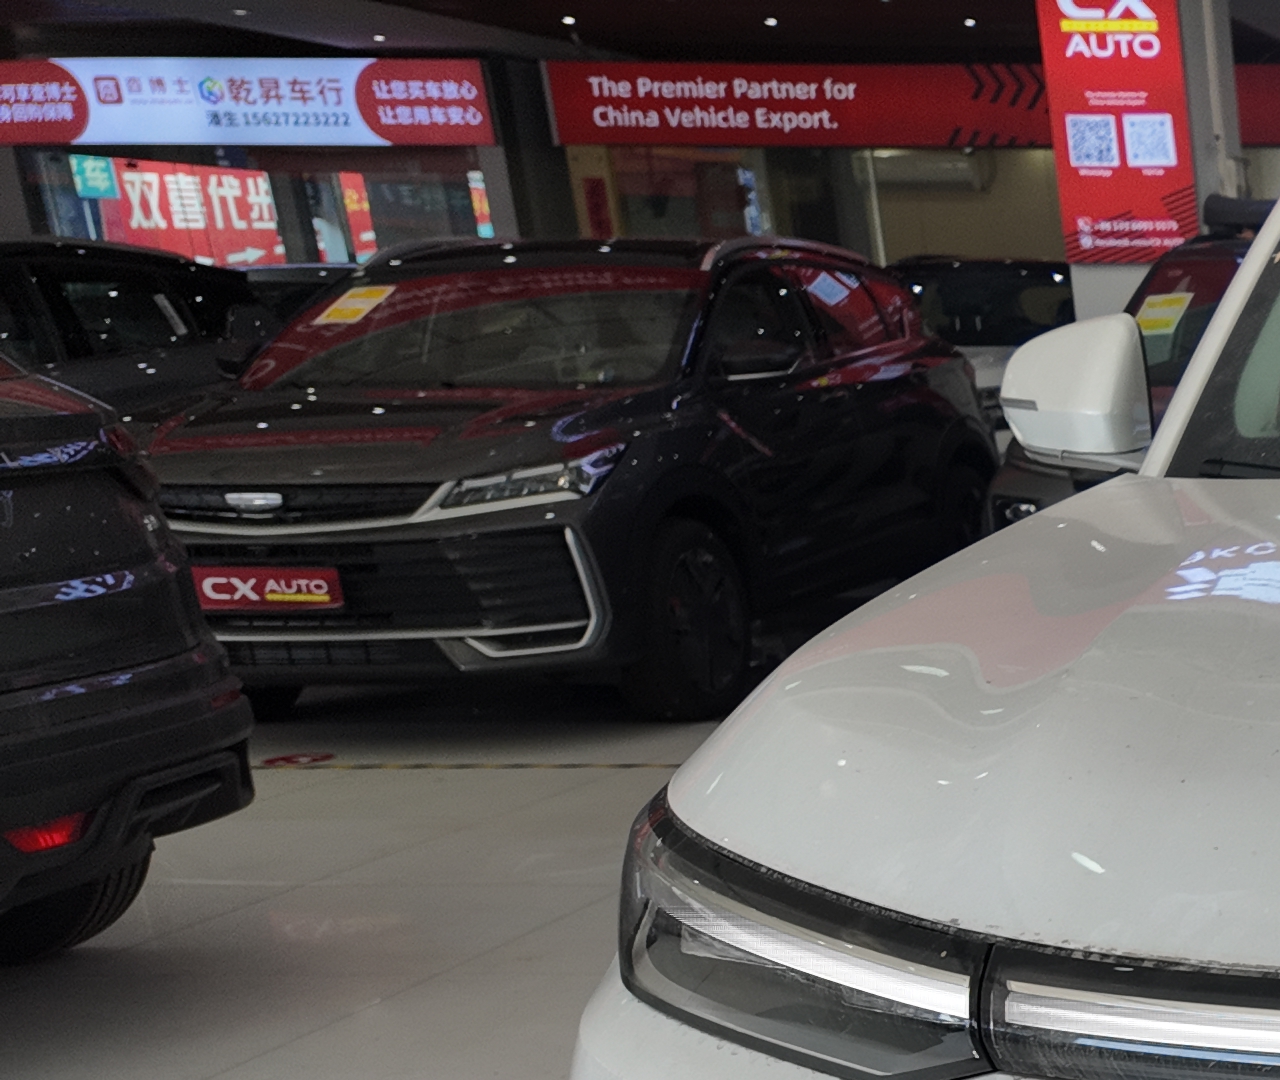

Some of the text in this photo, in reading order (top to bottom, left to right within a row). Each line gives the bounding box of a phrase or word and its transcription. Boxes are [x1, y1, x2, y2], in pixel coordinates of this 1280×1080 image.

[1065, 32, 1161, 58] AUTO
[589, 76, 857, 100] The Premier Partner for
[593, 105, 838, 132] China Vehicle Export.
[202, 577, 328, 600] CX AUTO
